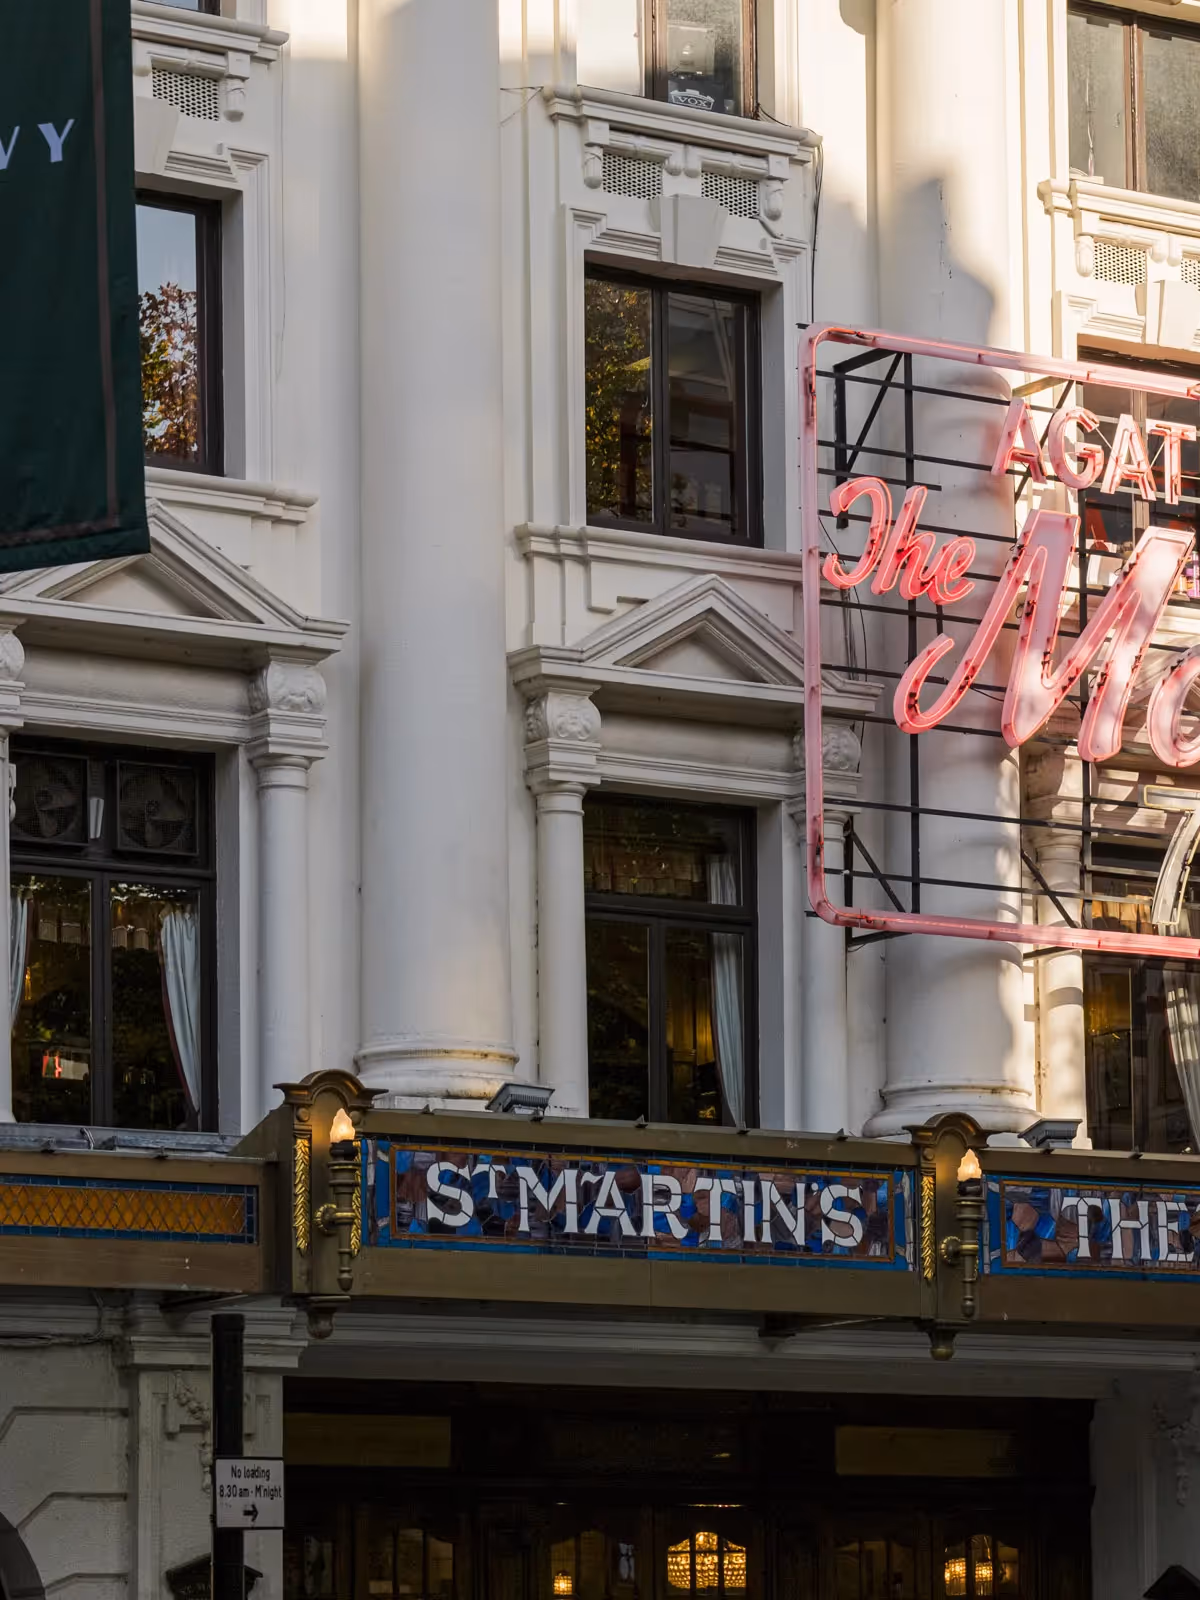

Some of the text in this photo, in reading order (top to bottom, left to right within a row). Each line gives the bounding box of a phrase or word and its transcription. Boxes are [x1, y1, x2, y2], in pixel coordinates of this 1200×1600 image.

[678, 96, 708, 107] VOX
[822, 477, 976, 605] The
[516, 1166, 865, 1248] MARTIN'S
[231, 1464, 271, 1481] No loading
[219, 1484, 238, 1498] 8.30
[238, 1487, 250, 1498] am
